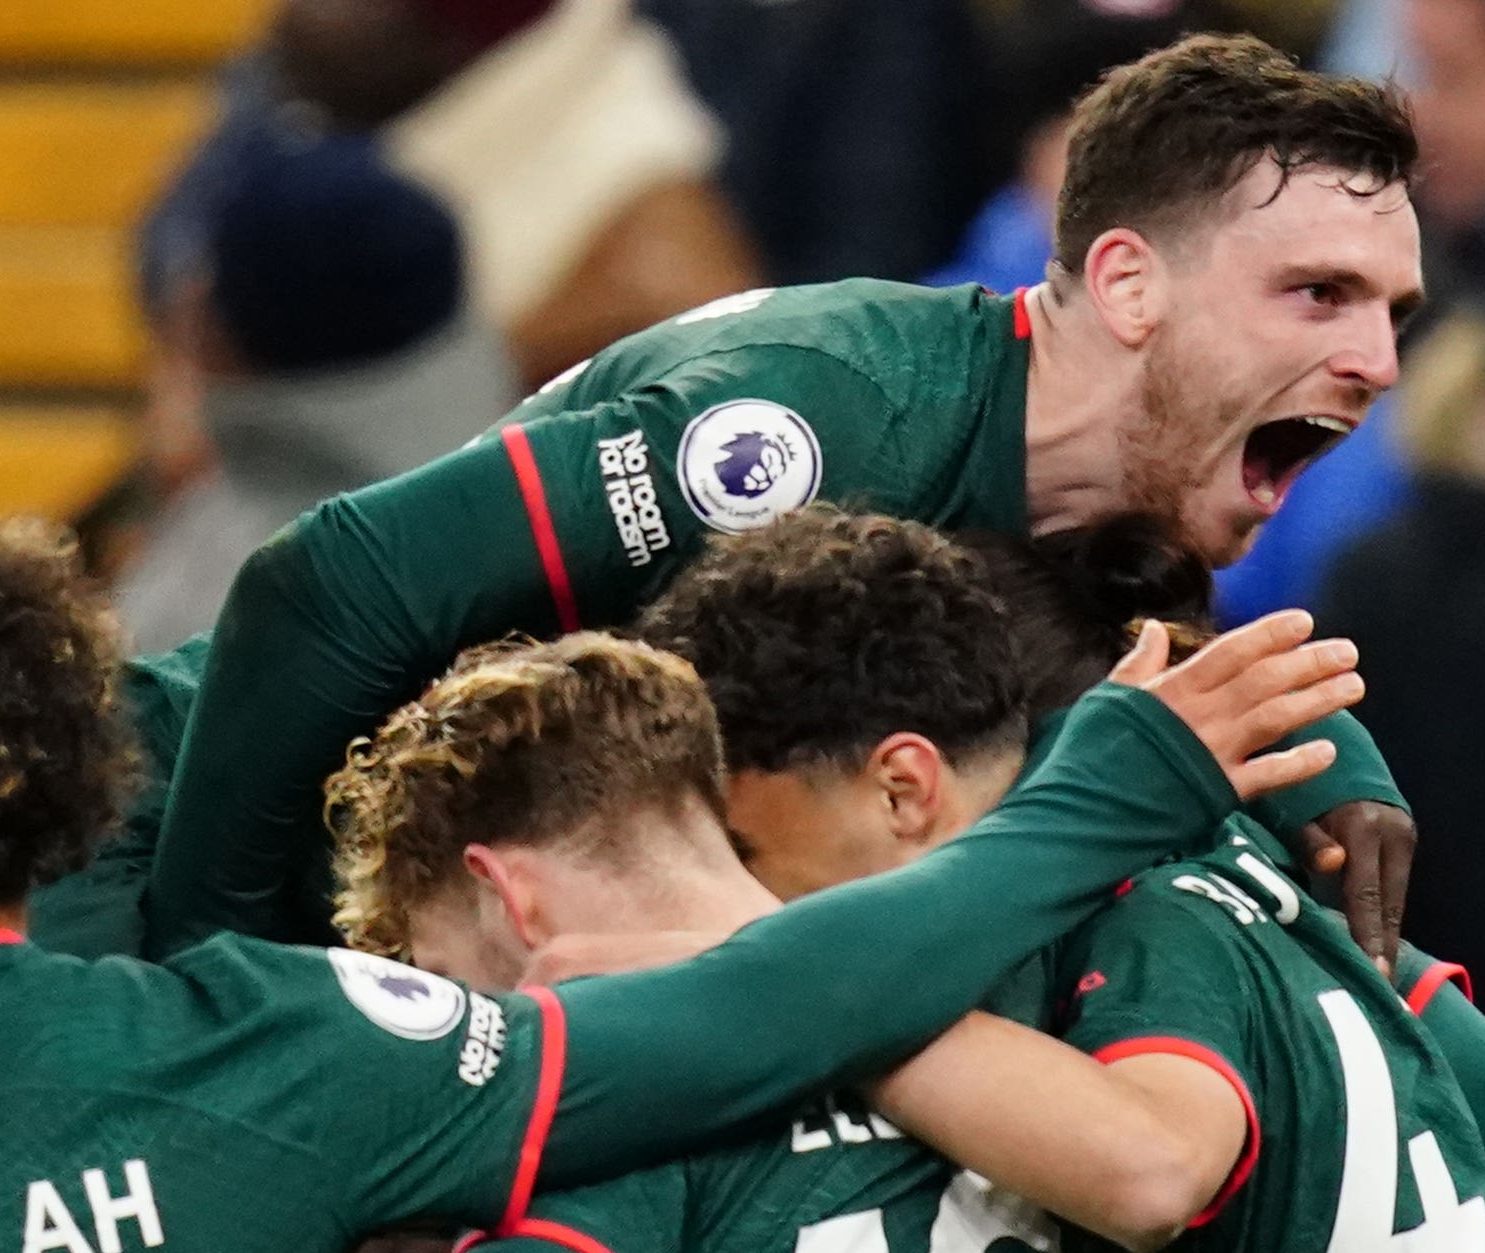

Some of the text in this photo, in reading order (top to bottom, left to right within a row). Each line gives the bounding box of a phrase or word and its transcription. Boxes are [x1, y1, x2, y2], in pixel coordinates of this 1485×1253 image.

[605, 478, 651, 567] racism
[617, 429, 670, 551] No room
